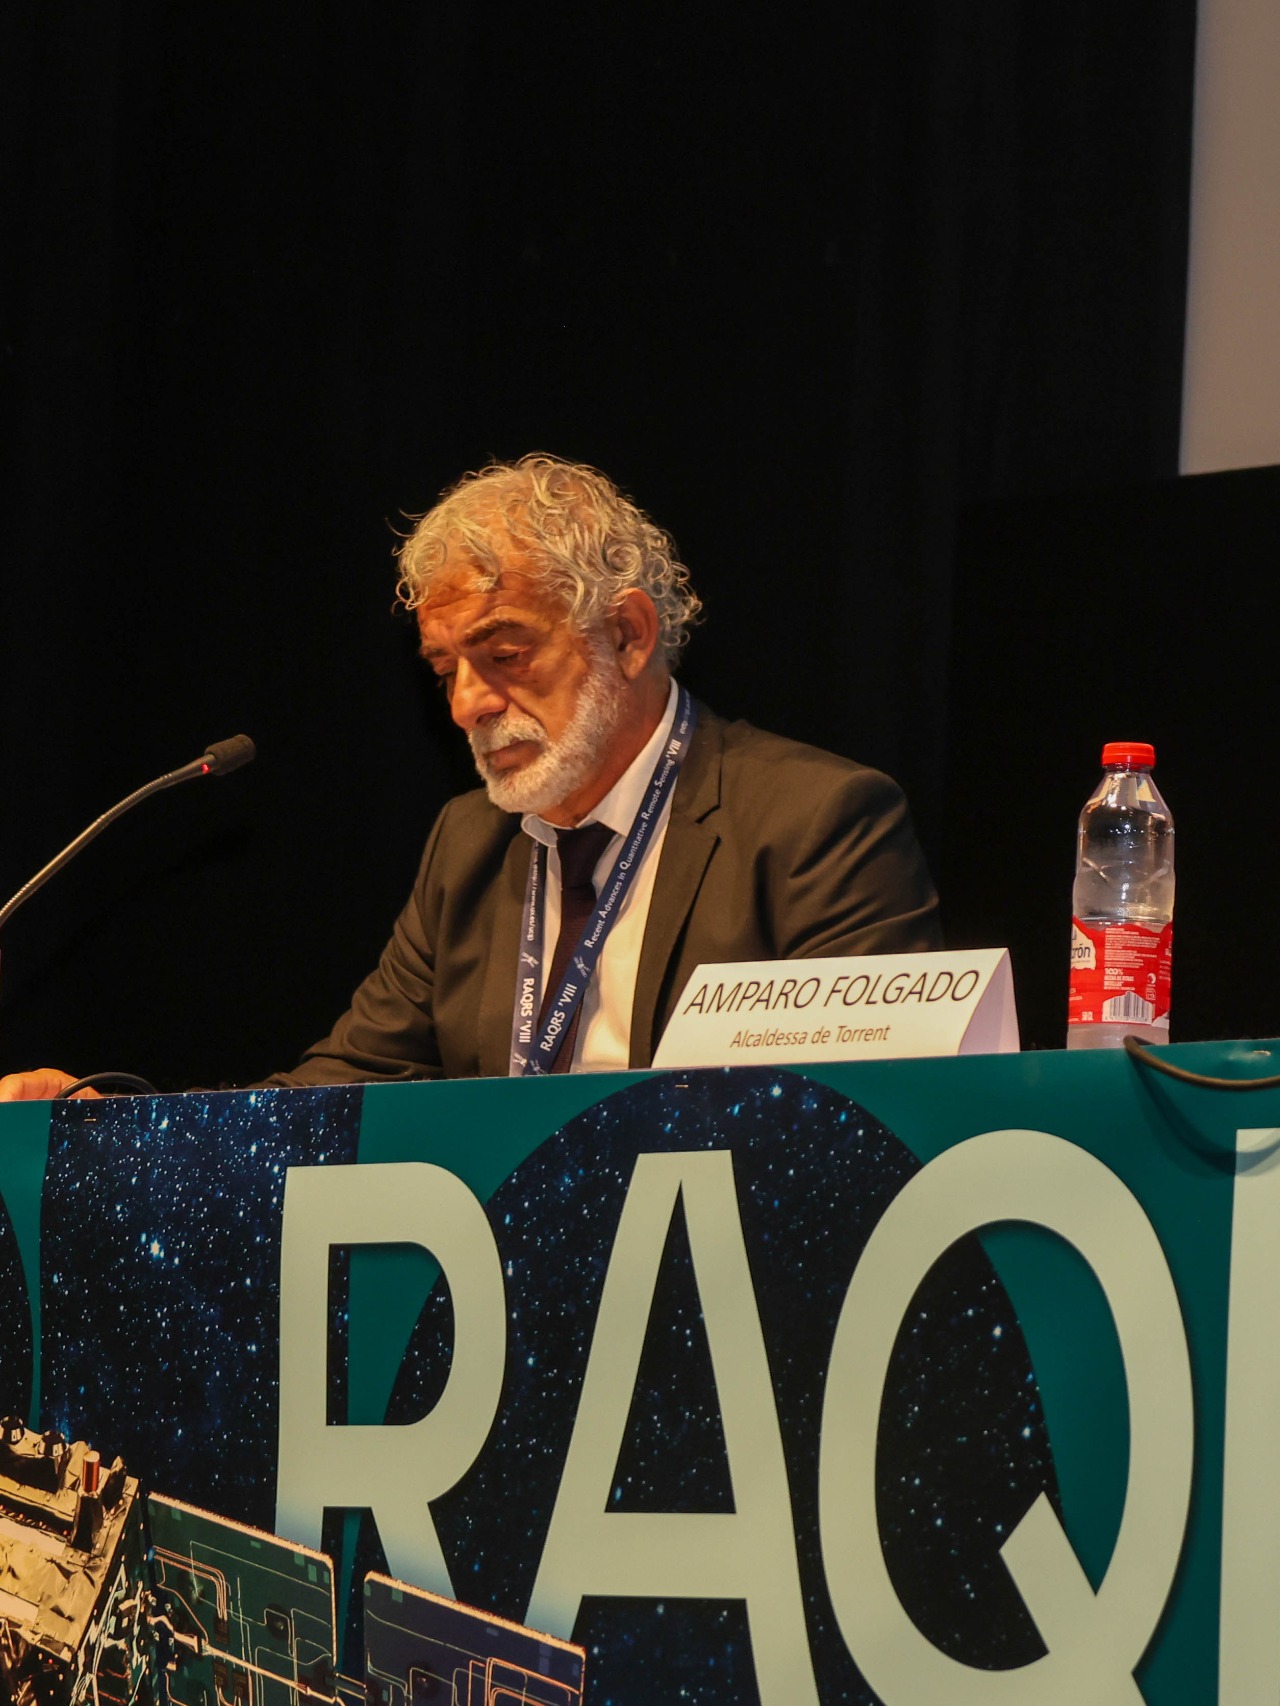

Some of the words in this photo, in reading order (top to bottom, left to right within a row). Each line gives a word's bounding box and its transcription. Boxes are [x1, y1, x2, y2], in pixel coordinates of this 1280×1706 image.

[654, 759, 676, 788] Sensing
[641, 789, 662, 821] Remote
[619, 822, 648, 871] Quantitative
[617, 872, 626, 882] in
[598, 881, 624, 920] Advances
[584, 919, 606, 949] Recent
[519, 977, 535, 1017] RAQRS
[683, 977, 821, 1015] AMPARO
[823, 969, 980, 1008] FOLGADO
[540, 1009, 566, 1052] RAQRS
[730, 1028, 807, 1048] Alcaldessa
[811, 1026, 831, 1044] de
[835, 1024, 892, 1043] Torrent
